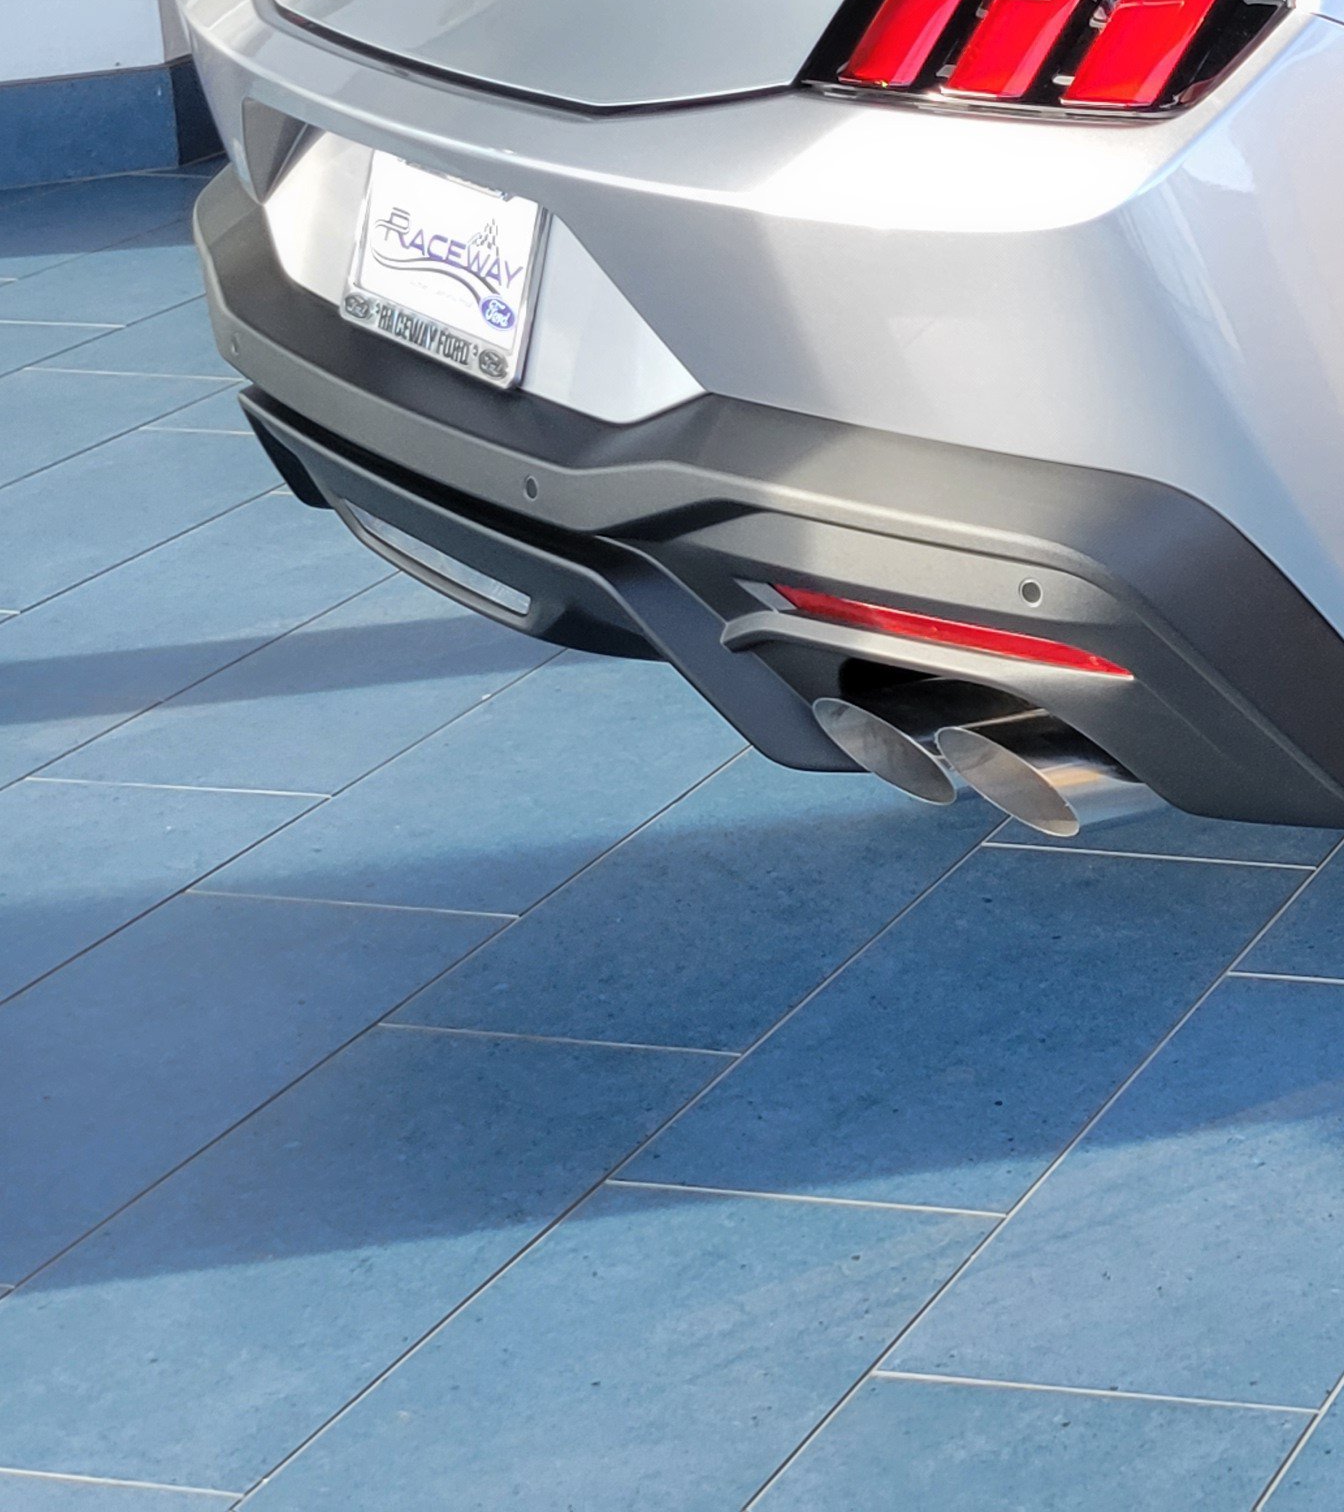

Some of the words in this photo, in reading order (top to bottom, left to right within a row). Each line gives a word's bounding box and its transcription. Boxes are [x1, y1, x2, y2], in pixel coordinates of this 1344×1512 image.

[375, 207, 524, 289] RACEWAY
[378, 304, 437, 350] RACEWAY
[484, 299, 515, 328] Ford
